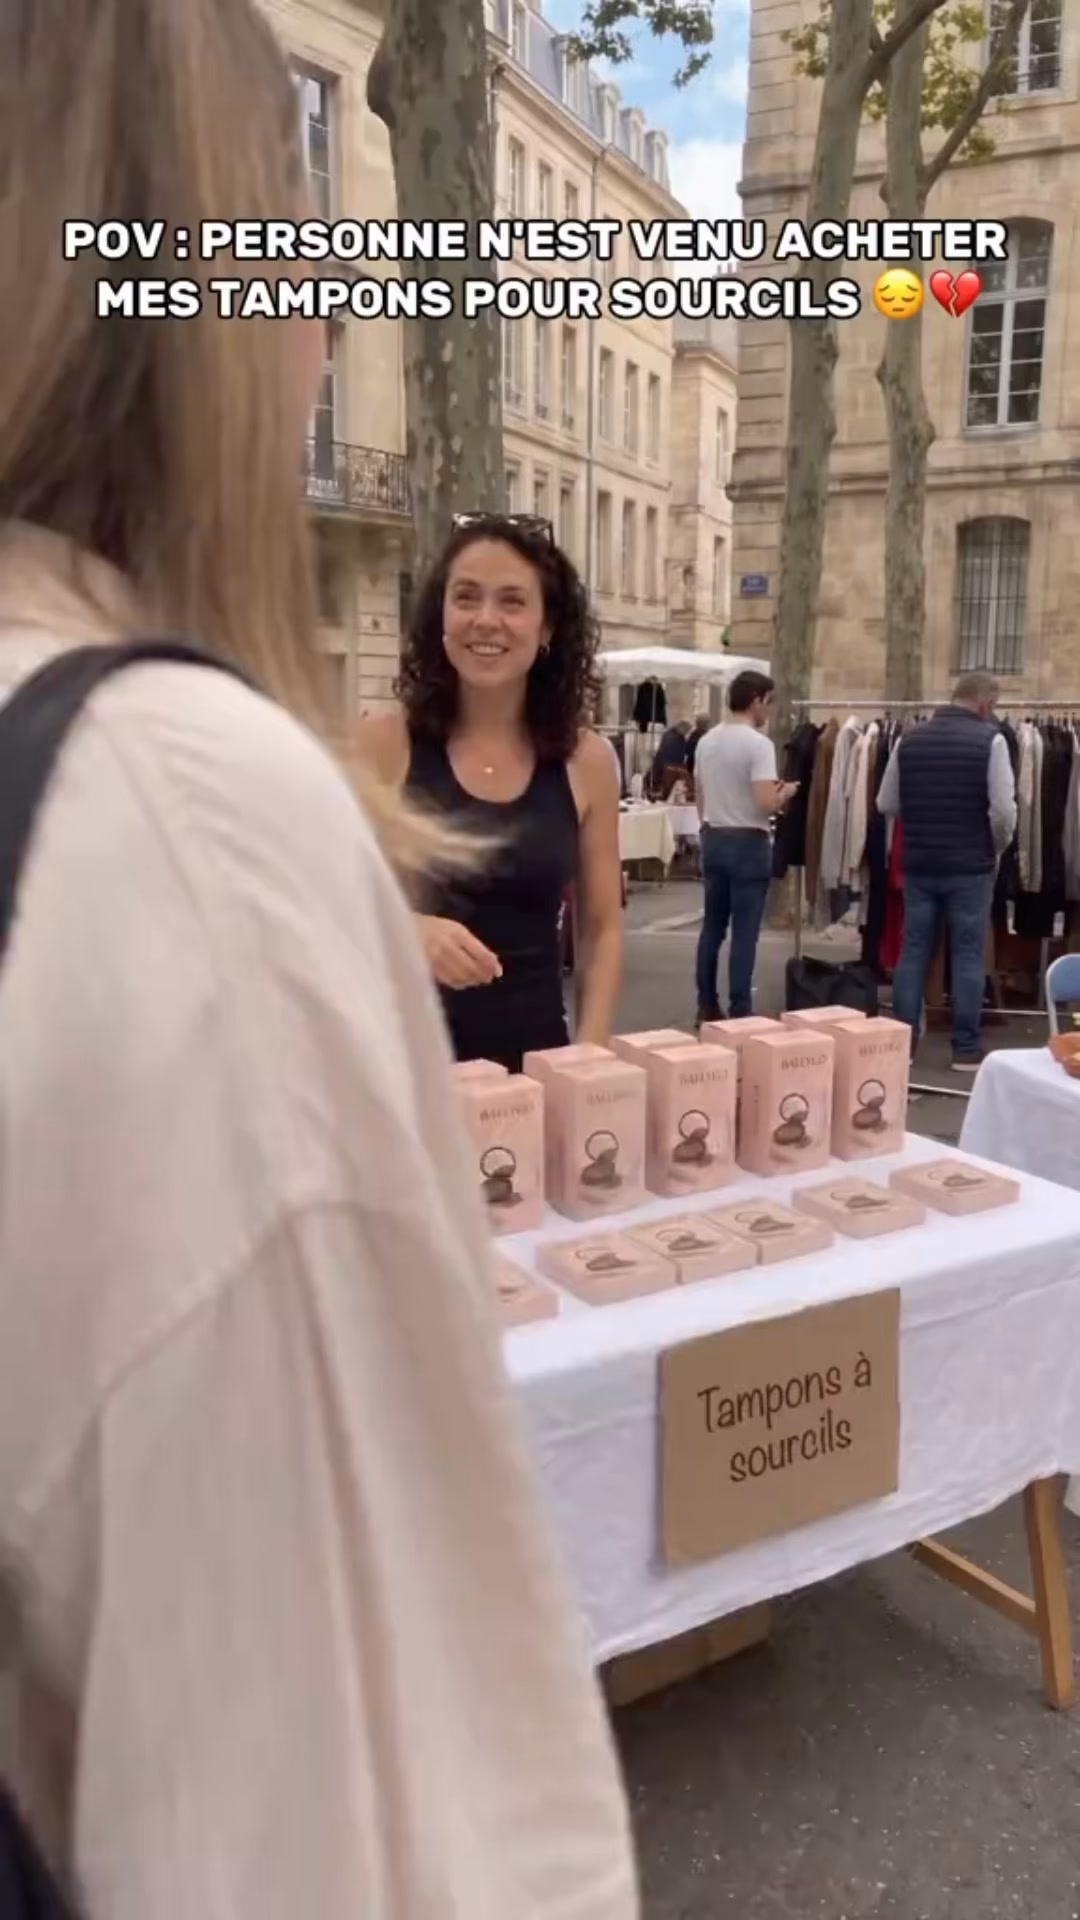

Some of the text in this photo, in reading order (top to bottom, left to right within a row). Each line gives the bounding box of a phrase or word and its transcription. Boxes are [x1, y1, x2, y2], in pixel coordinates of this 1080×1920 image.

[697, 1351, 872, 1433] Tampons à
[729, 1408, 853, 1483] sourcils
